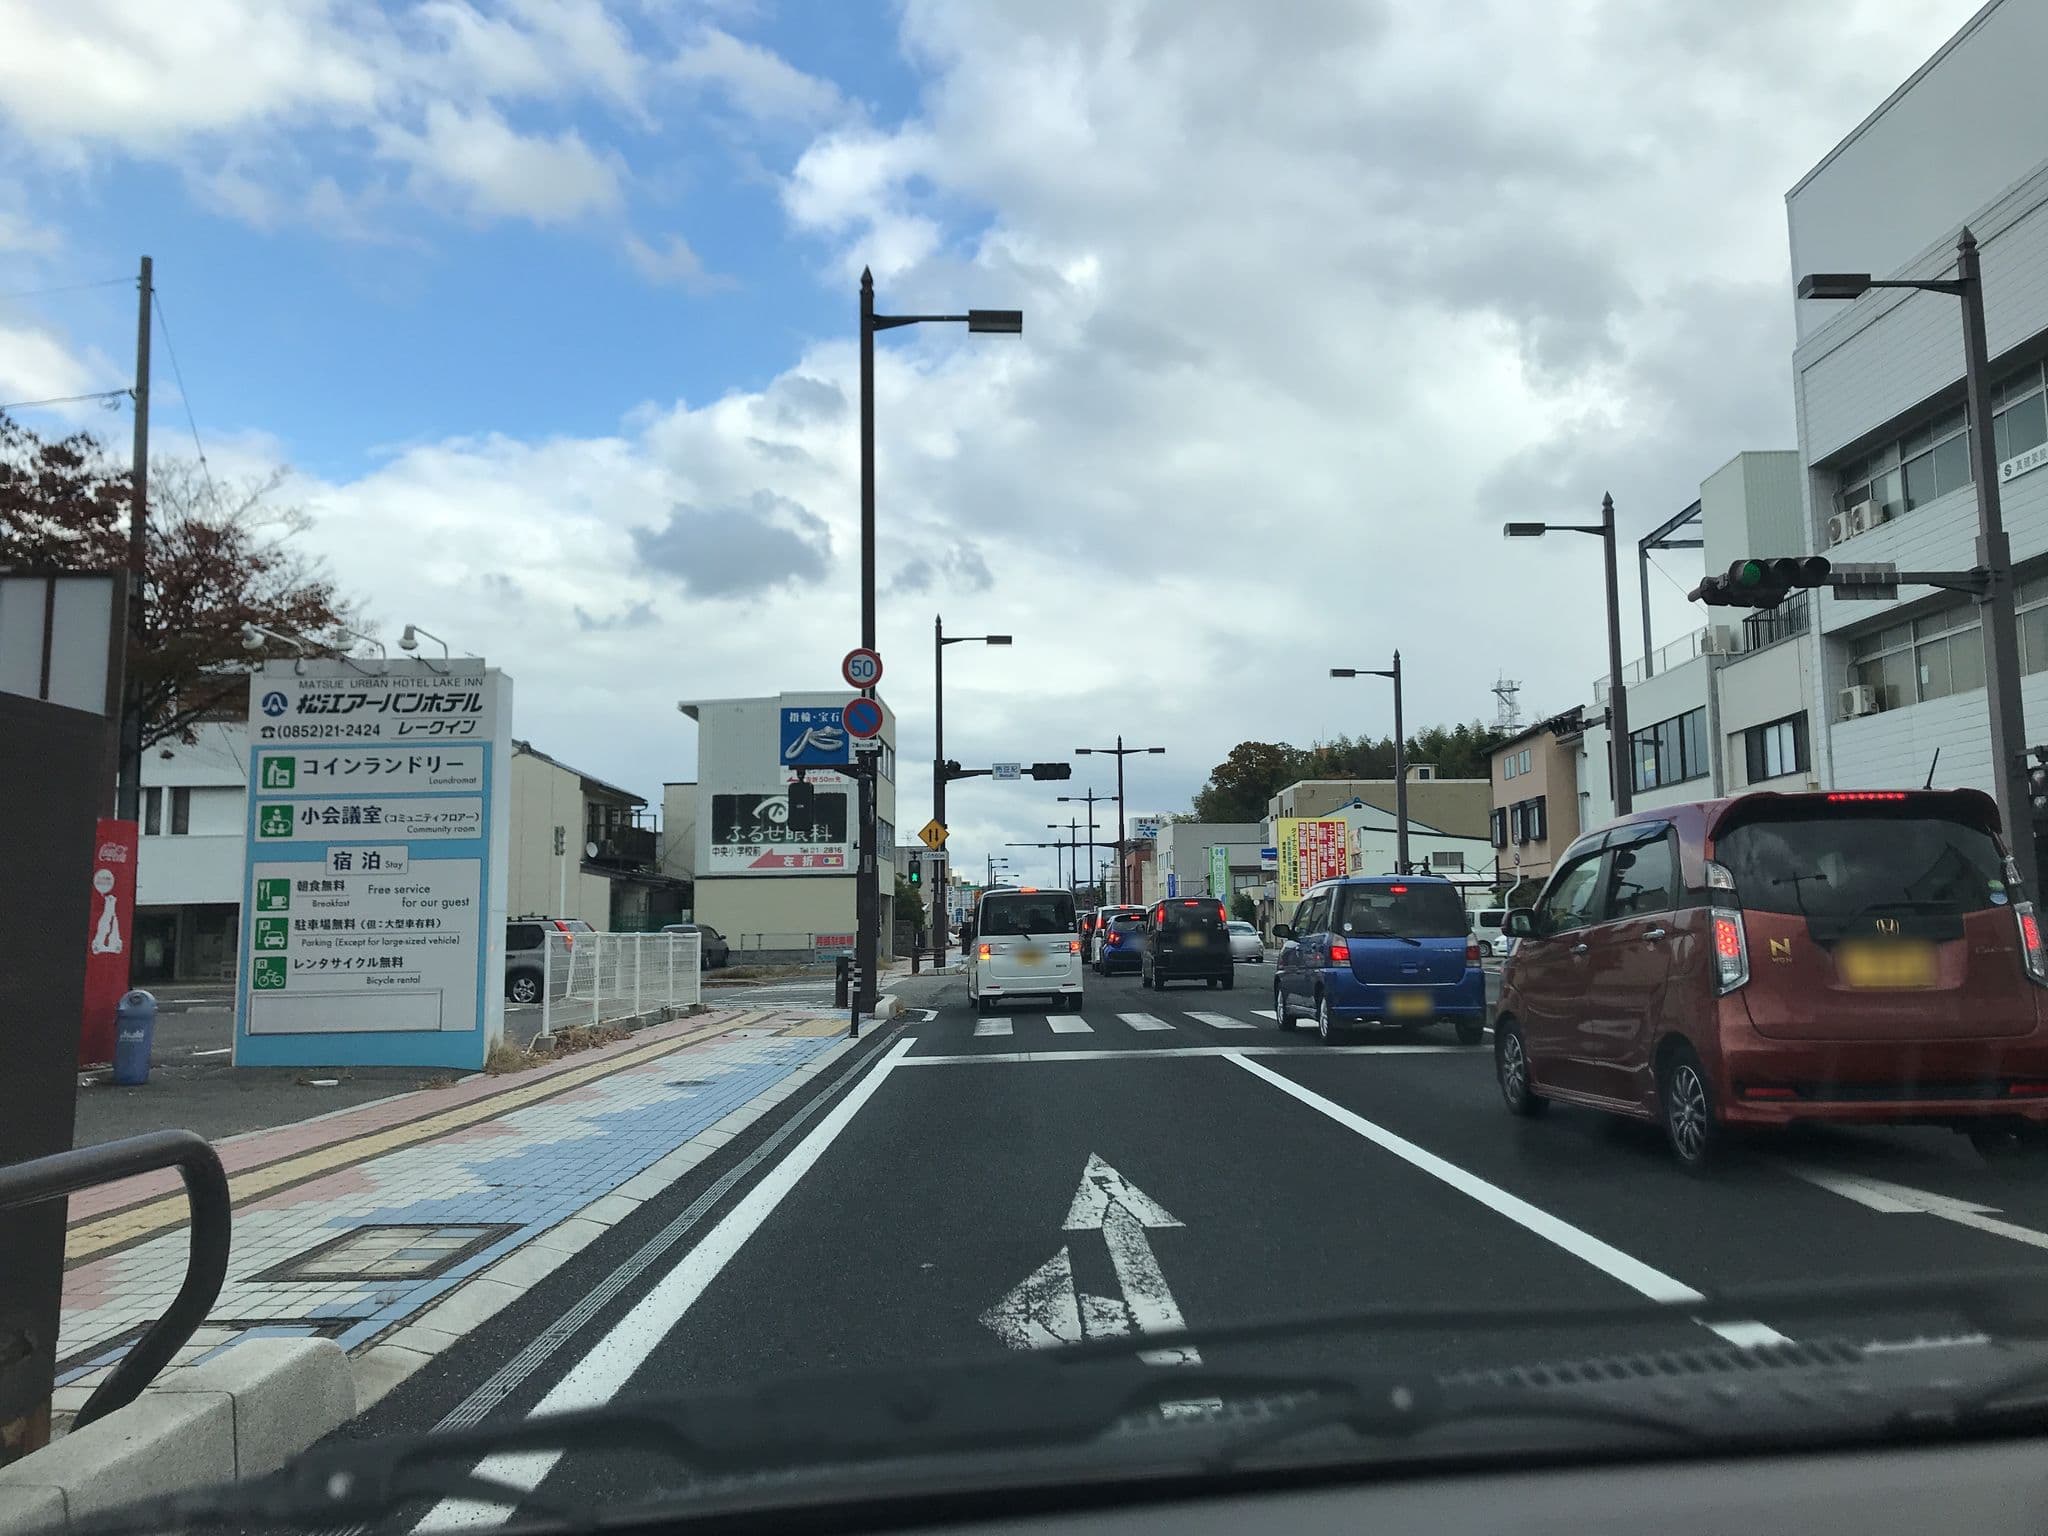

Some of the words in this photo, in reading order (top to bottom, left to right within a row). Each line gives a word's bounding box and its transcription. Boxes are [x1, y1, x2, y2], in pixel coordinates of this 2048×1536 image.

[851, 660, 874, 677] 50
[299, 680, 344, 689] MATSUE
[350, 679, 389, 688] URBAN
[393, 678, 430, 688] HOTEL
[433, 678, 464, 687] LAKE
[465, 677, 483, 686] INN
[296, 693, 483, 714] 松江アーバンホテル
[277, 724, 381, 739] (0852)21-2424
[399, 720, 476, 736] レークイン
[303, 755, 464, 776] コインランドリー
[407, 825, 451, 834] Community
[726, 824, 832, 843] ふるせ眼科
[333, 851, 381, 870] 宿泊
[385, 860, 403, 869] Stay
[297, 880, 345, 892] 朝食無料
[368, 885, 391, 894] Free
[394, 884, 431, 894] service
[312, 899, 350, 908] Breakfast
[402, 897, 418, 908] for
[420, 899, 438, 907] our
[442, 898, 470, 909] guest
[301, 939, 332, 948] Parking
[367, 938, 380, 946] for
[1769, 938, 1791, 955] N
[294, 957, 404, 969] レンタサイクル無料
[366, 976, 394, 985] Bicycle
[397, 974, 420, 984] rental
